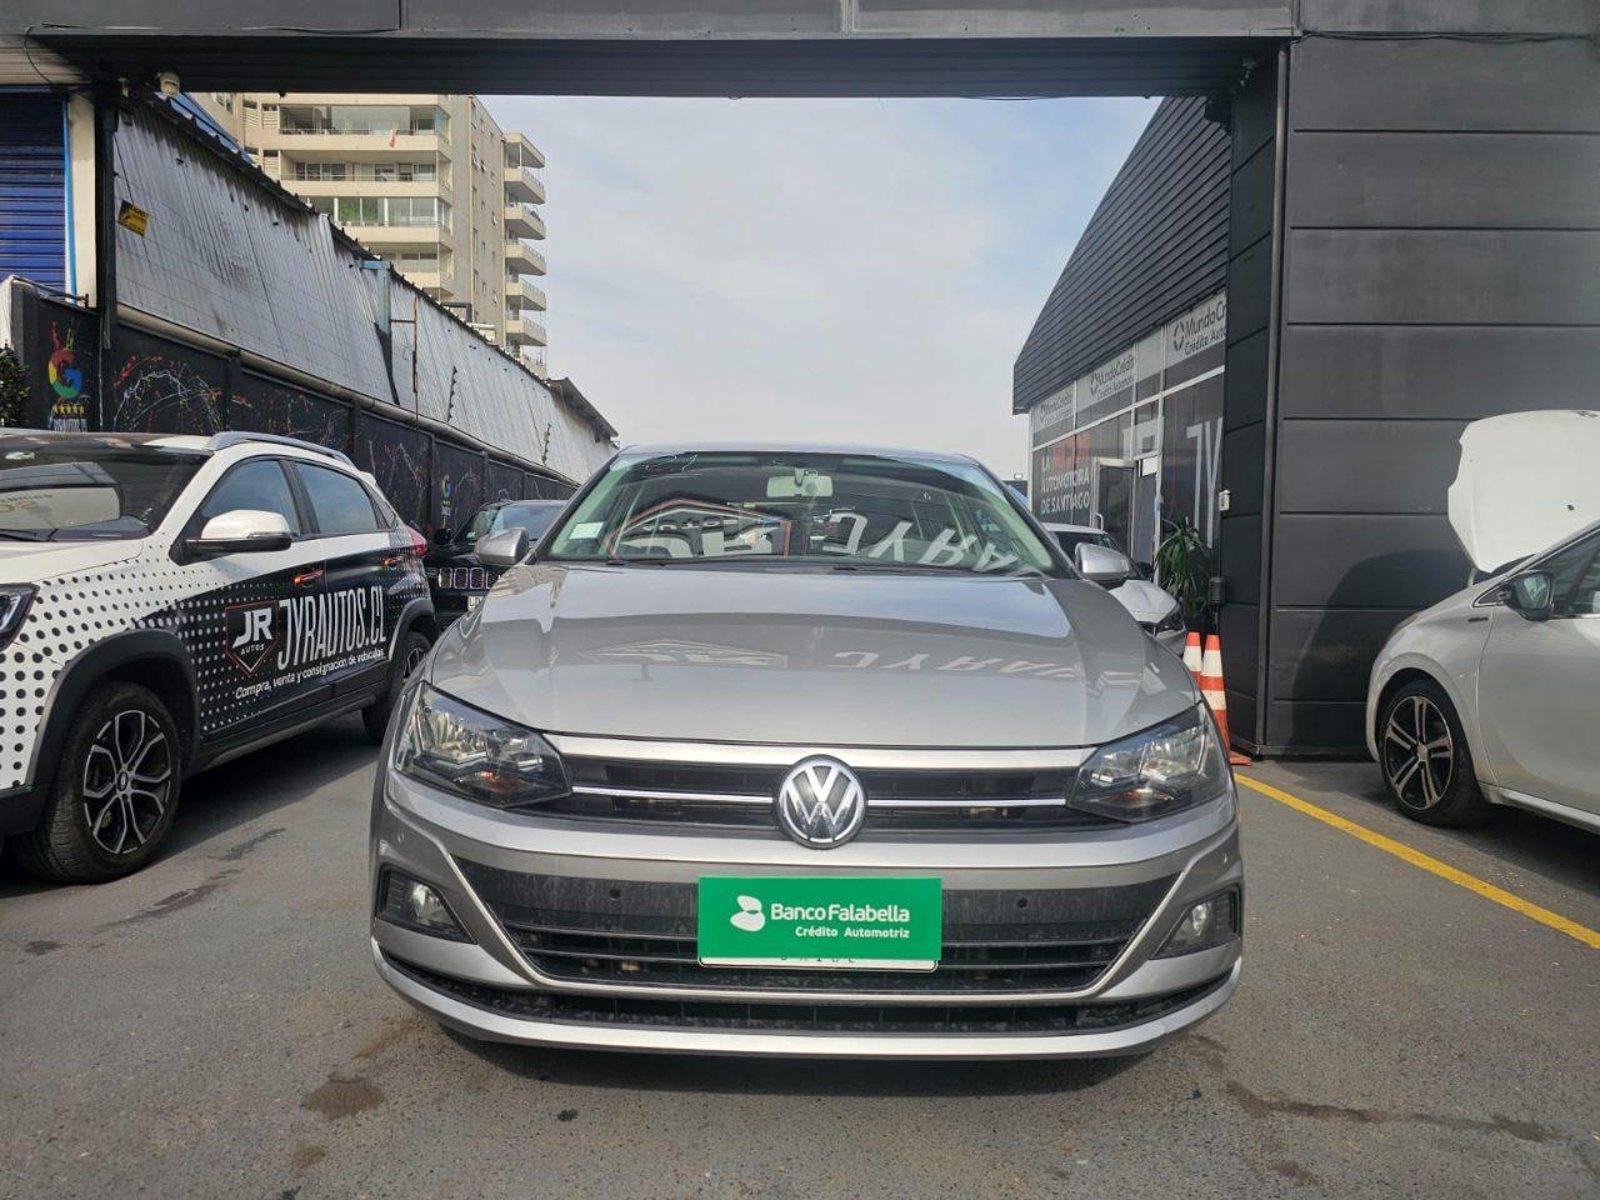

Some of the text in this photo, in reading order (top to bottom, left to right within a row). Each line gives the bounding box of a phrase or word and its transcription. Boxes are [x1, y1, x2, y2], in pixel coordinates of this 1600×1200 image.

[1041, 467, 1090, 493] AUTOMOTORA
[1041, 491, 1090, 515] DE SANTIAGO
[232, 608, 273, 649] JR
[277, 585, 386, 670] JYRAUTOS.CL
[240, 644, 265, 655] AUTOS
[235, 680, 272, 699] Compra,
[273, 673, 295, 688] venta
[295, 671, 302, 683] y
[348, 654, 357, 665] de
[770, 903, 910, 922] Banco Falabella
[795, 926, 910, 938] Crédito Automotriz
